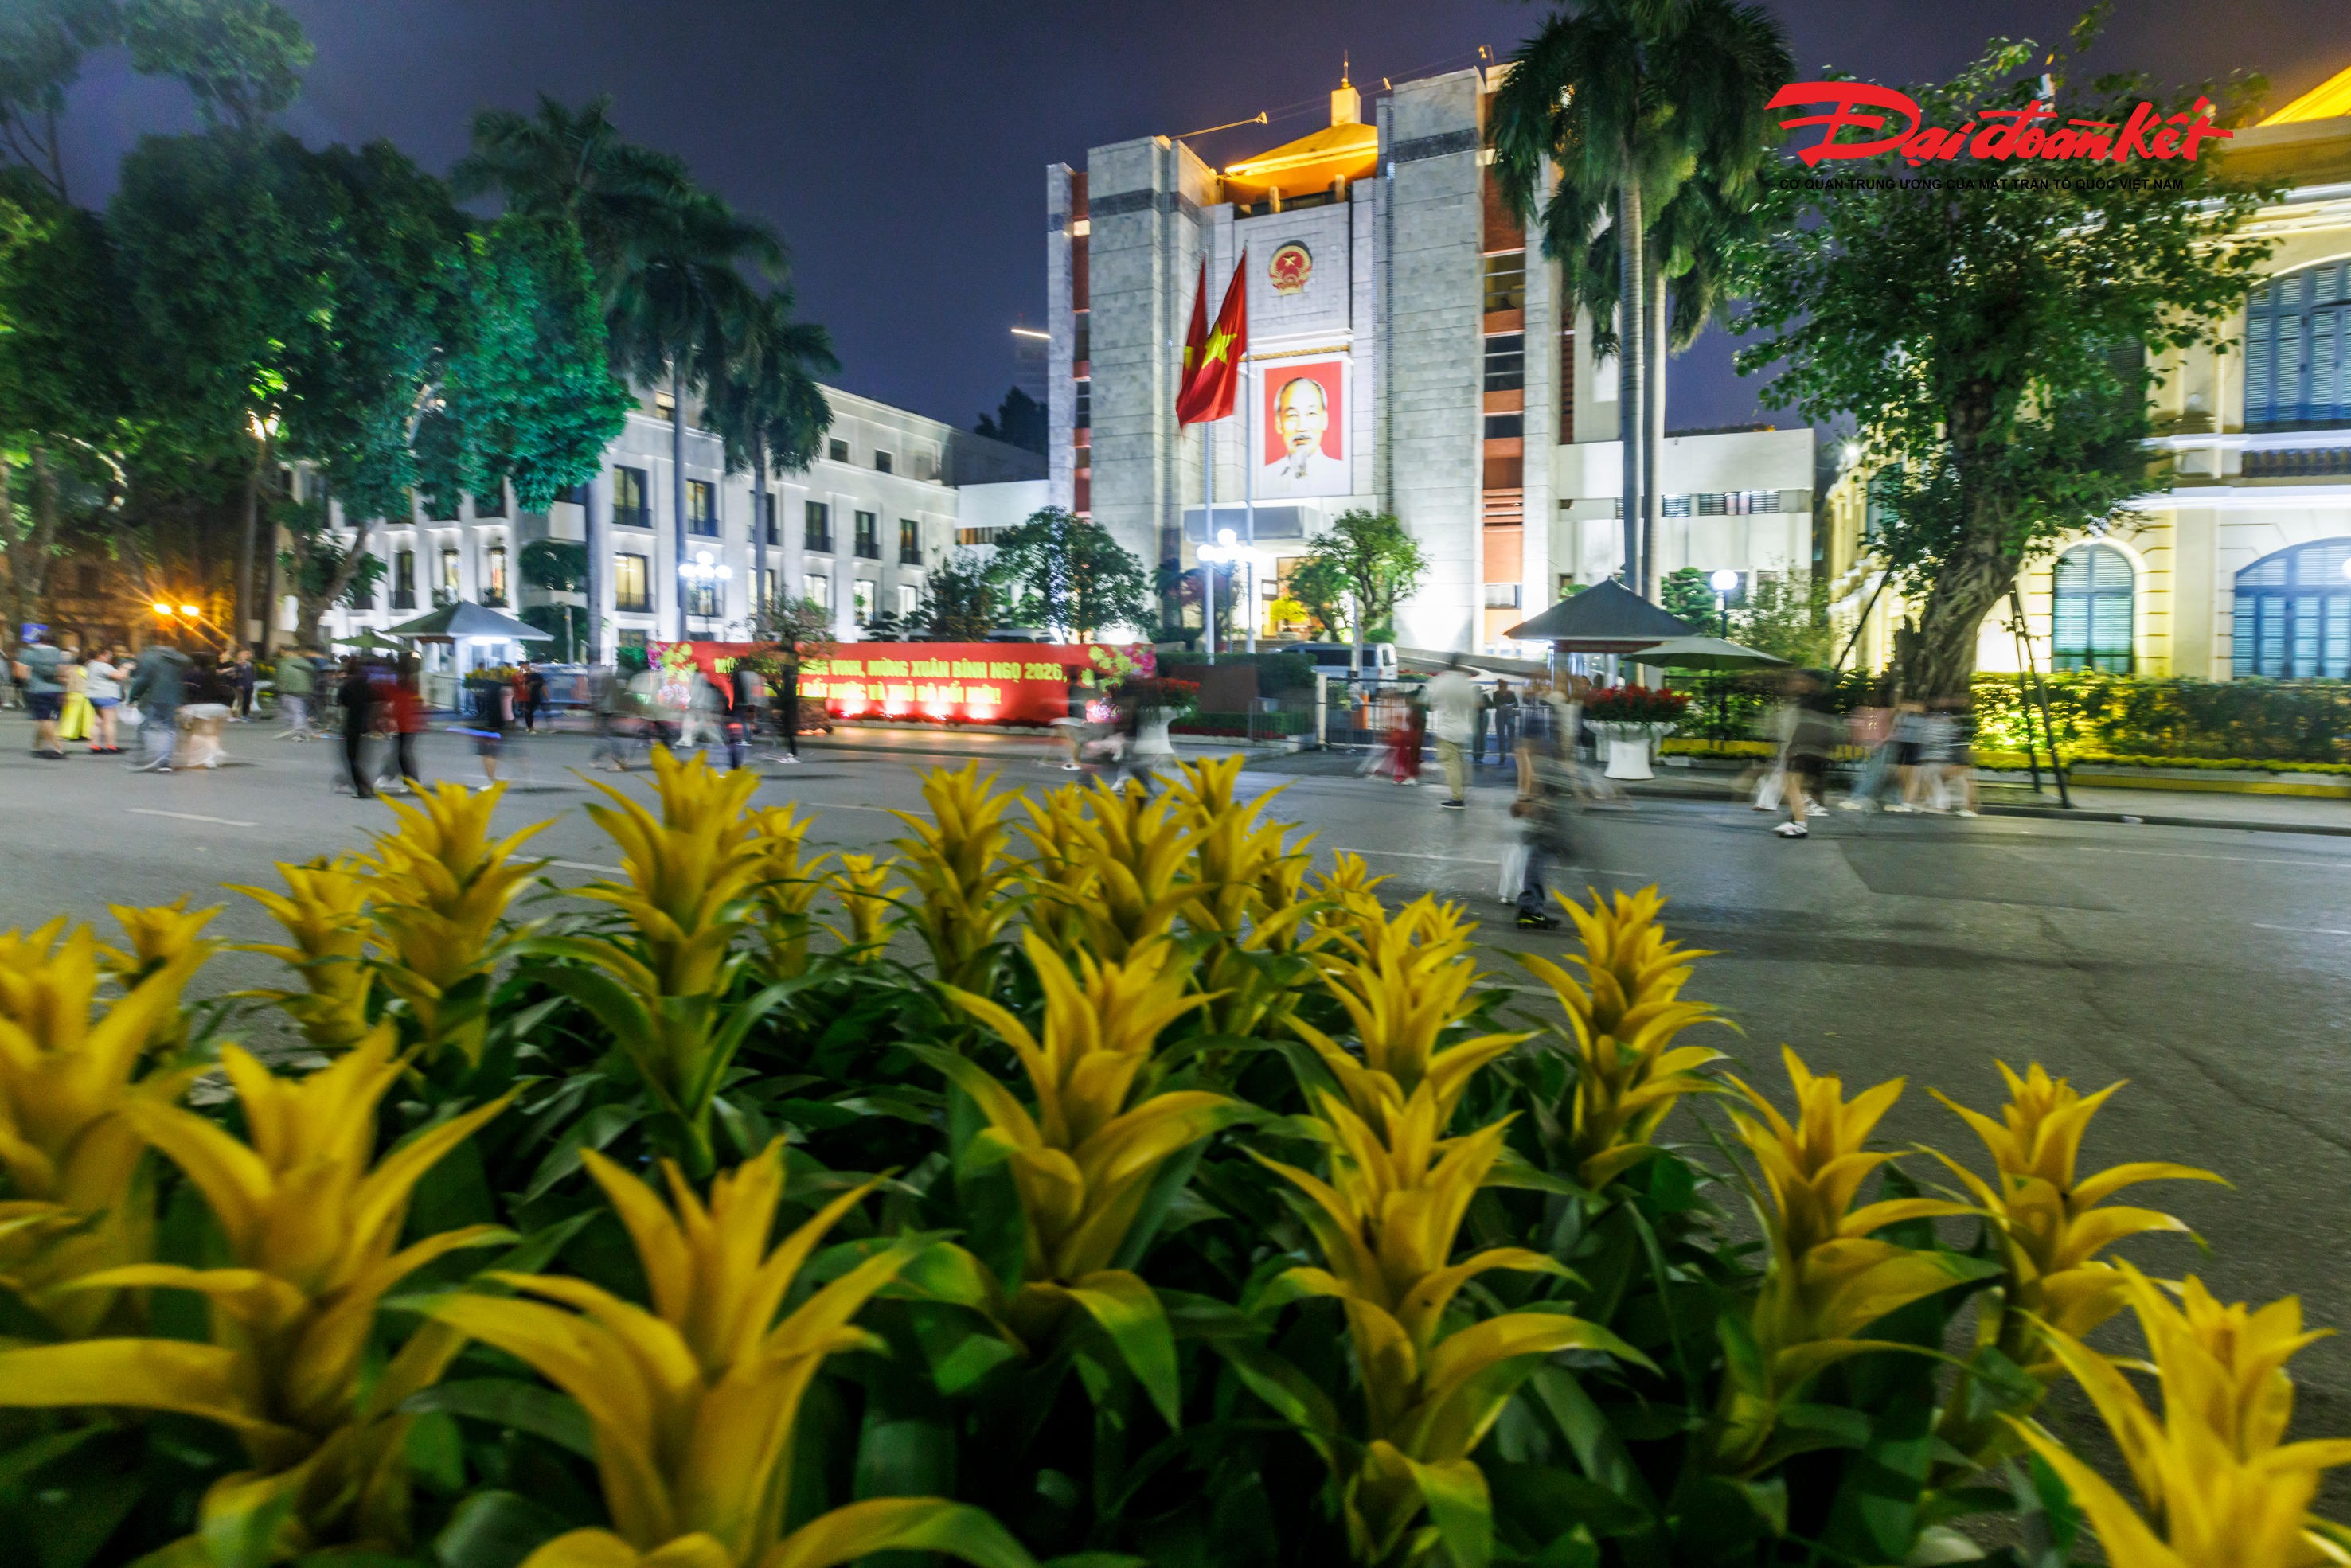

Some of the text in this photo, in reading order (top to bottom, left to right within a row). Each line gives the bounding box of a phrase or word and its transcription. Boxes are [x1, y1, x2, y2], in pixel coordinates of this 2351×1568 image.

[911, 657, 951, 678] XUÂN
[990, 662, 1021, 683] NGỌ
[1025, 662, 1067, 682] 2026,
